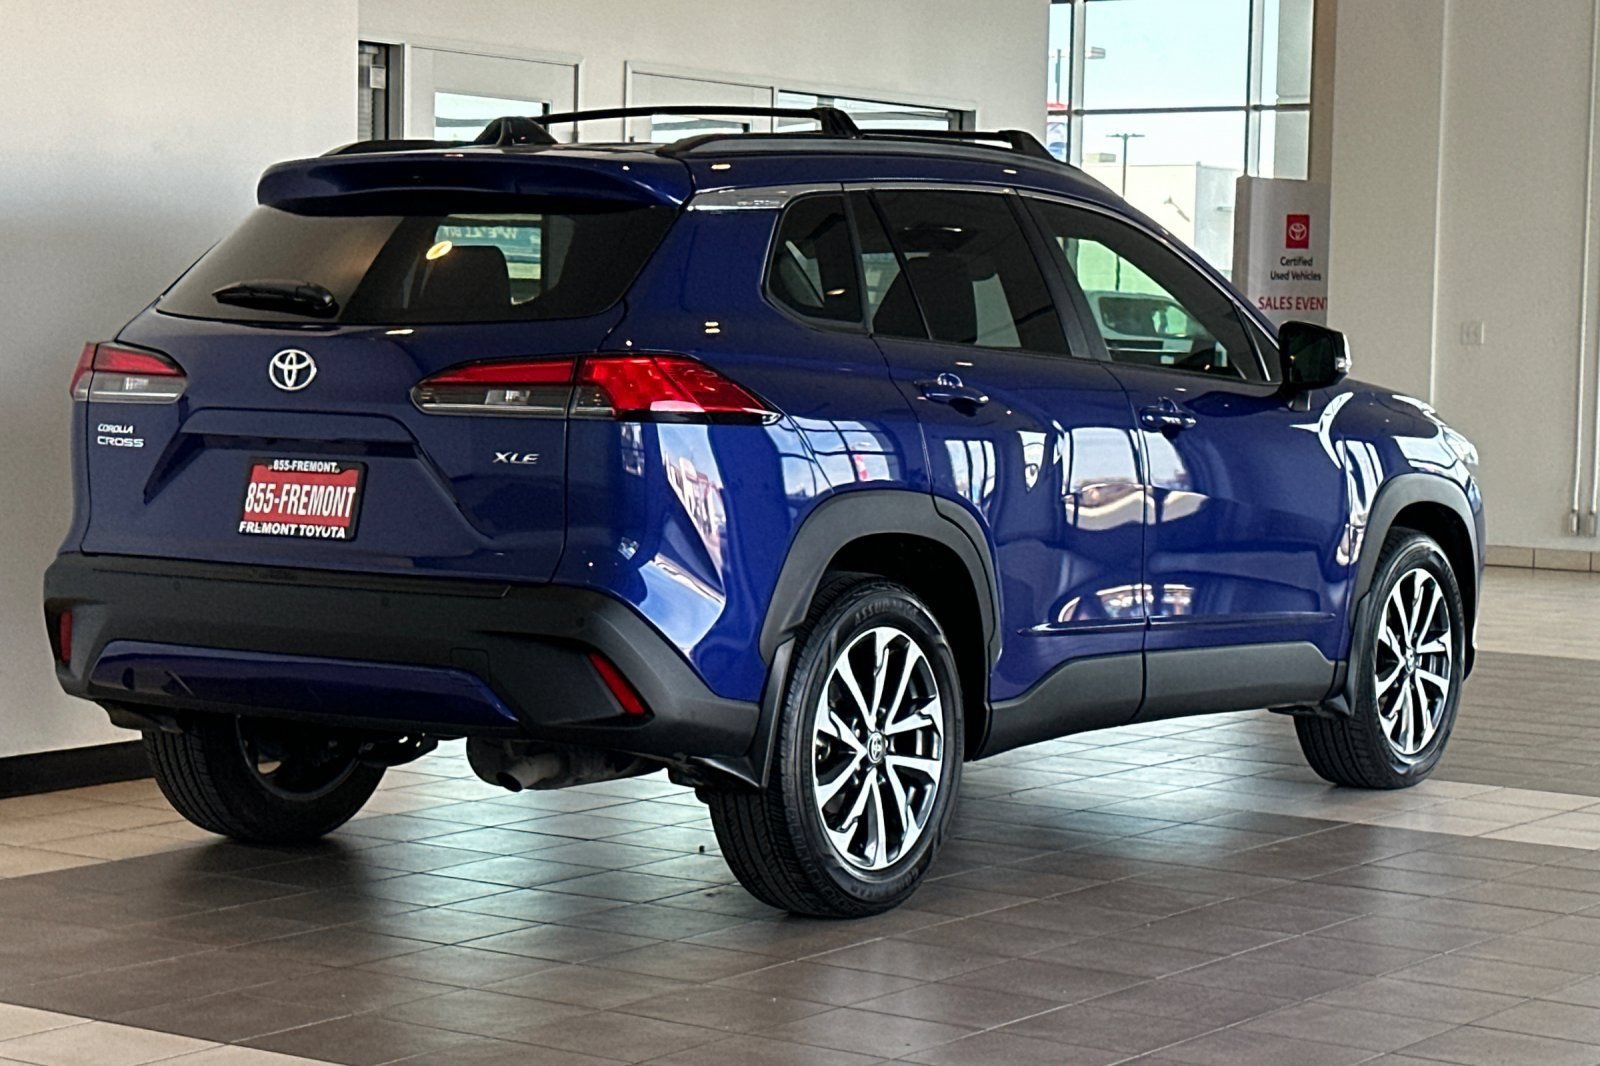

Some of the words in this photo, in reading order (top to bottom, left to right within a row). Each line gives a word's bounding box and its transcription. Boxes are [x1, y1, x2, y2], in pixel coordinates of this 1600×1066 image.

[1280, 256, 1313, 267] Certified
[1270, 270, 1289, 281] Used
[1291, 270, 1322, 281] Vehicles
[1258, 296, 1293, 311] SALES
[97, 423, 134, 434] COROLLA
[97, 435, 145, 448] CROSS
[492, 451, 540, 465] XLE
[273, 459, 338, 473] 855-FREMONT
[244, 482, 356, 518] 855-FREMONT
[238, 521, 298, 536] FREMONT
